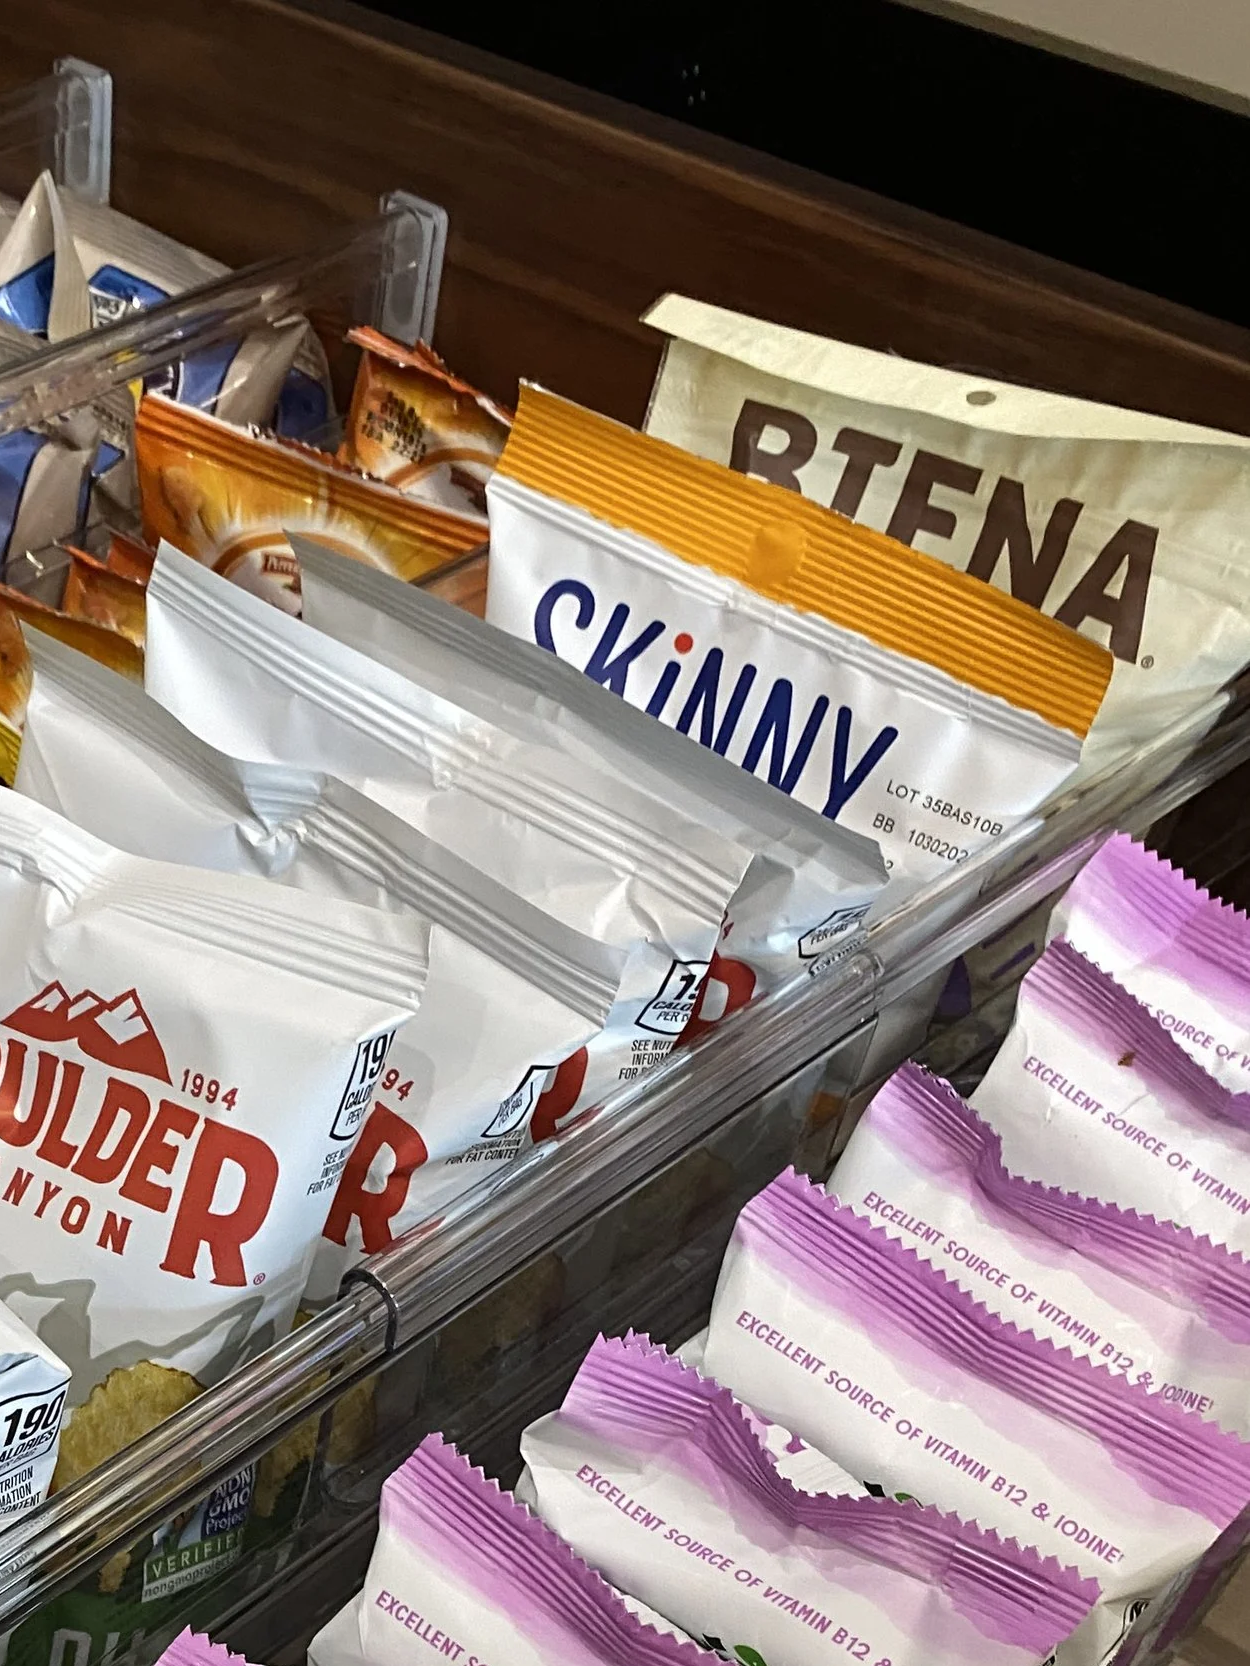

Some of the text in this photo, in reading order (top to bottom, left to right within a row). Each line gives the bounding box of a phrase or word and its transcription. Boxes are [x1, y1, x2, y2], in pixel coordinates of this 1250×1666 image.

[886, 777, 920, 805] LOT
[872, 812, 896, 835] BB
[632, 1039, 651, 1051] SEE
[1156, 1008, 1239, 1063] SOURCE OF
[180, 1067, 238, 1112] 1994
[381, 1068, 415, 1102] 94
[619, 1067, 638, 1080] FOR
[1023, 1056, 1103, 1117] EXCELLENT
[1101, 1112, 1166, 1158] SOURCE
[1166, 1152, 1193, 1174] OF
[484, 1147, 519, 1161] CONTE
[862, 1191, 945, 1248] EXCELLENT
[943, 1240, 1010, 1290] SOURCE
[1010, 1283, 1038, 1306] OF
[1037, 1299, 1101, 1349] VITAMIN
[1100, 1342, 1134, 1374] B12
[1137, 1370, 1155, 1389] &
[3, 1392, 64, 1448] 190
[734, 1310, 826, 1375] EXCELLENT
[824, 1370, 896, 1424] SOURCE
[895, 1419, 924, 1442] OF
[923, 1435, 991, 1483] VITAMIN
[991, 1475, 1028, 1508] B12
[1031, 1501, 1050, 1522] &
[208, 1487, 250, 1518] GMO
[214, 1466, 254, 1500] NON
[576, 1464, 666, 1532] EXCELLENT
[664, 1529, 734, 1572] SOURCE
[734, 1568, 764, 1589] OF
[762, 1585, 833, 1634] VITAMIN
[831, 1627, 871, 1662] B12
[375, 1590, 465, 1662] EXCELLENT
